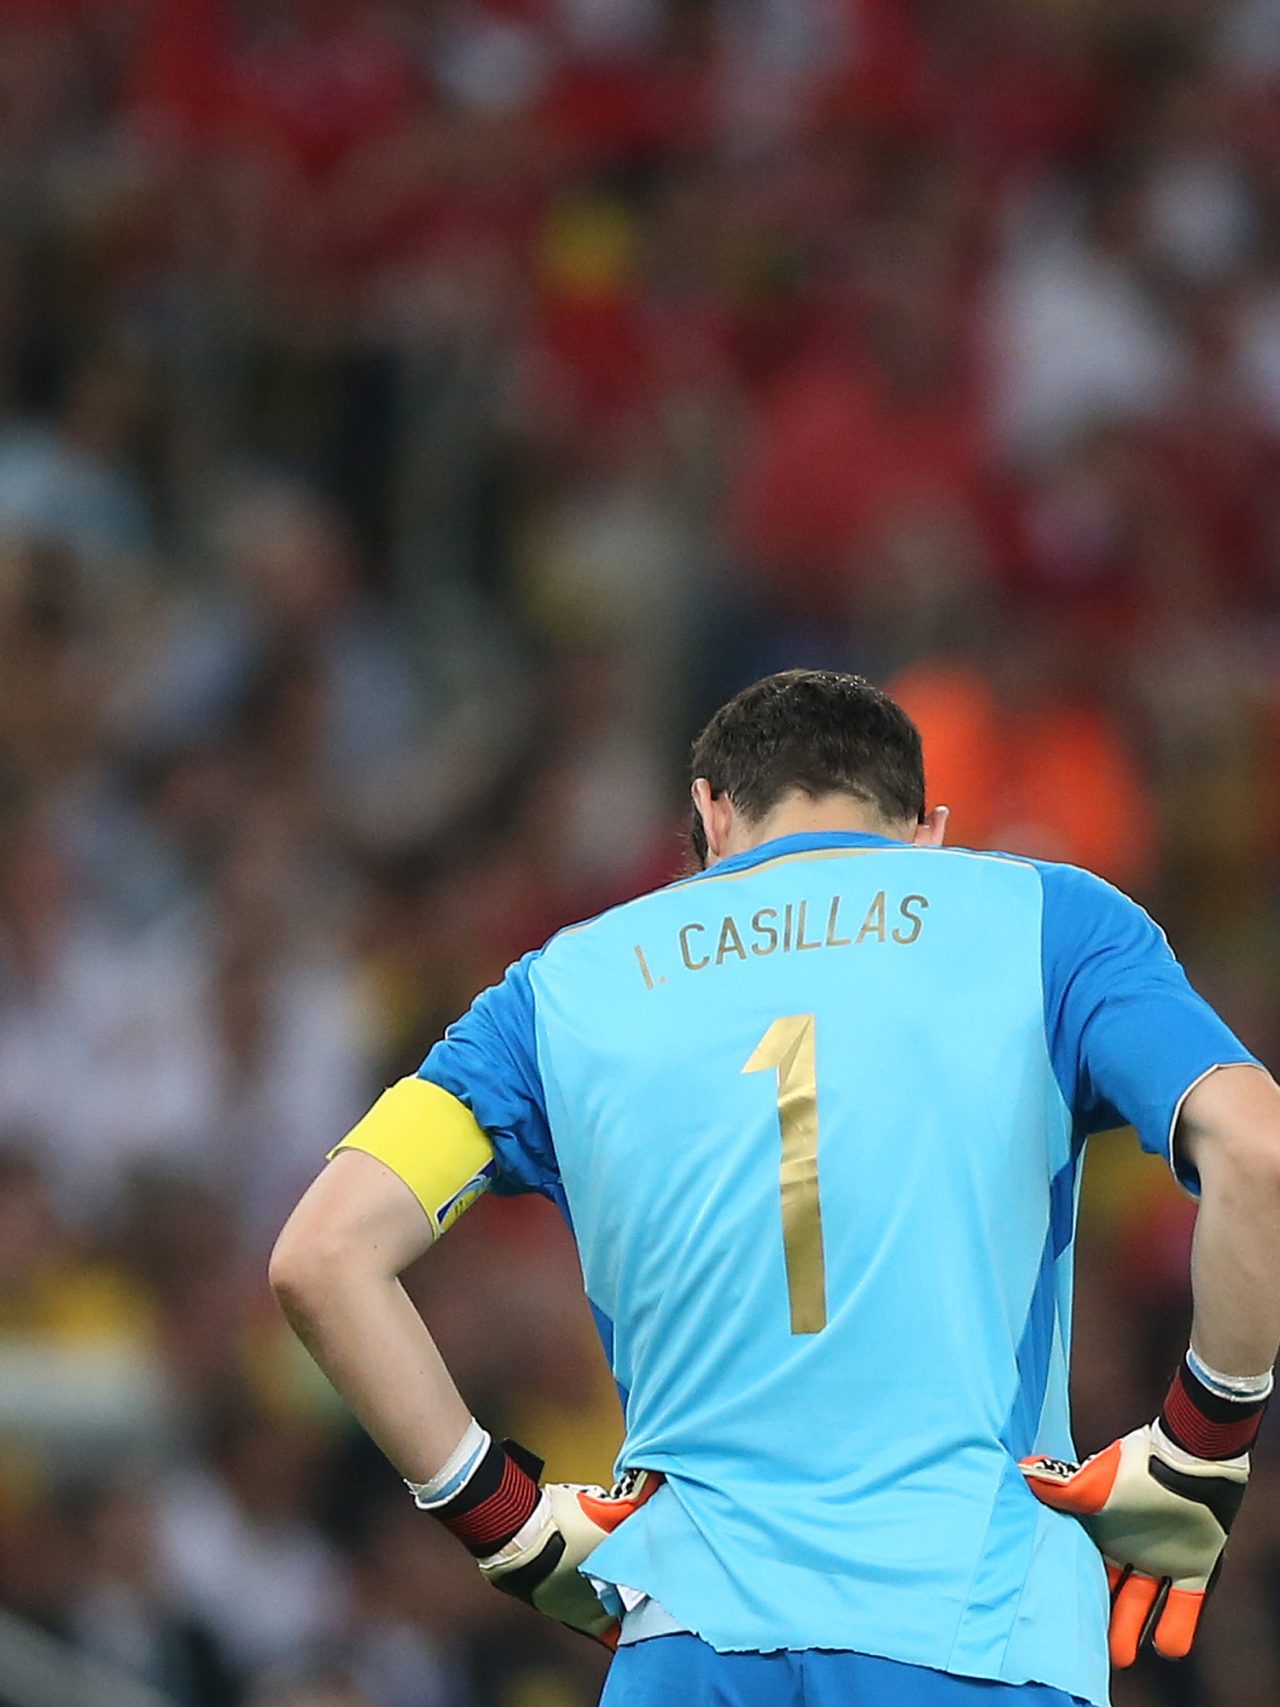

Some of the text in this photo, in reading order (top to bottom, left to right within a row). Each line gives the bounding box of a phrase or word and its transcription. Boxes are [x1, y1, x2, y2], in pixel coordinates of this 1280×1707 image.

[633, 890, 929, 990] I. CASILLAS
[740, 1013, 827, 1335] 1
